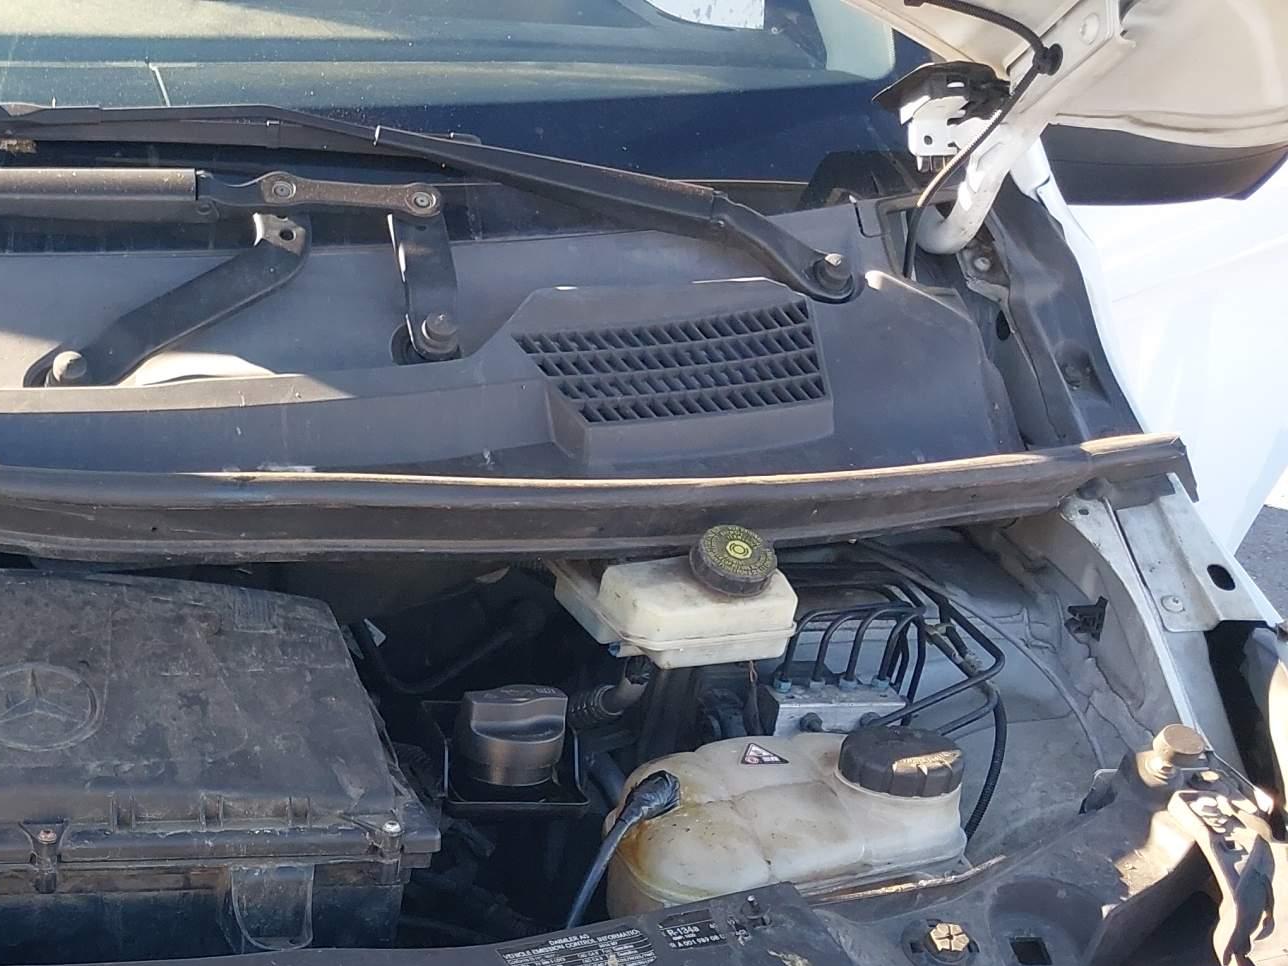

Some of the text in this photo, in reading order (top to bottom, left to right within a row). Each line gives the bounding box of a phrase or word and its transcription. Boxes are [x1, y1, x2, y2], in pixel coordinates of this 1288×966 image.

[666, 926, 700, 937] R-134a
[502, 950, 532, 960] VEHICLE
[531, 944, 565, 955] EMISSION
[565, 938, 597, 949] CONTROL
[596, 929, 642, 942] INFORMATIO
[548, 935, 579, 946] DAIMLER
